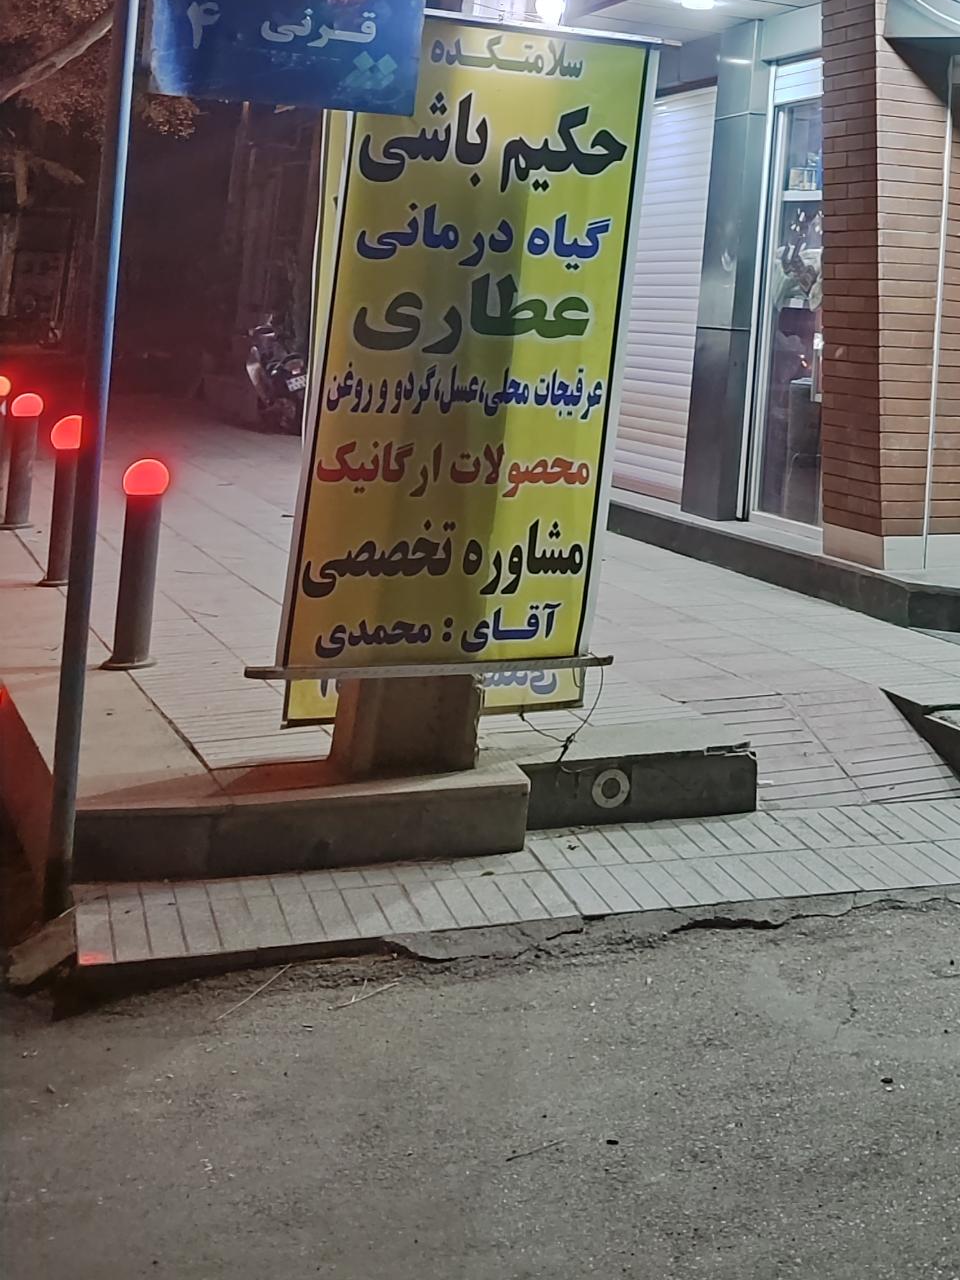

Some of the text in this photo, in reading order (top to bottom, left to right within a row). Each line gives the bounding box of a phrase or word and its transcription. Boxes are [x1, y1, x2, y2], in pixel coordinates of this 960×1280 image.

[186, 1, 377, 50] قرنی ۴
[358, 91, 628, 193] حکیم باشی
[526, 213, 612, 272] گیاه
[352, 272, 591, 355] عطاری
[325, 361, 373, 414] روغن
[533, 367, 604, 421] عرقیجات
[449, 441, 590, 498] محصولات
[302, 517, 584, 598] مشاوره تخصصی
[315, 617, 432, 659] محمدی
[460, 602, 562, 653] آقای
